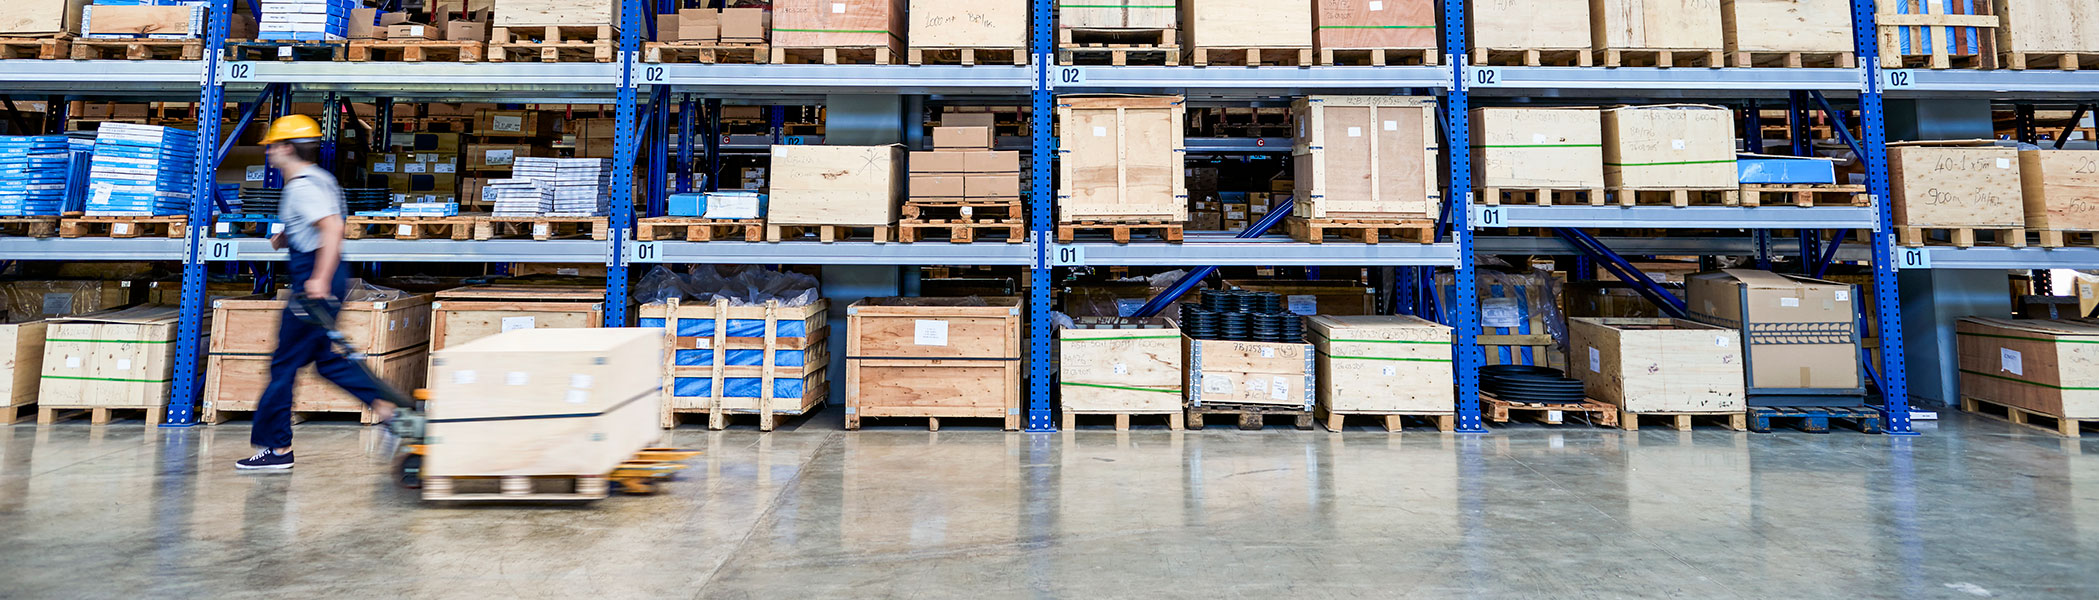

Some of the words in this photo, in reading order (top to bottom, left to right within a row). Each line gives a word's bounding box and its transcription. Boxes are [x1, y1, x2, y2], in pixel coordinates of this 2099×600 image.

[231, 63, 249, 79] 02
[646, 66, 664, 82] 02
[1062, 68, 1079, 83] 02
[1477, 69, 1495, 84] 02
[1890, 71, 1909, 86] 02
[1483, 209, 1500, 225] 01
[213, 242, 230, 258] 01
[638, 243, 655, 259] 01
[1060, 247, 1077, 263] 01
[1906, 250, 1923, 266] 01
